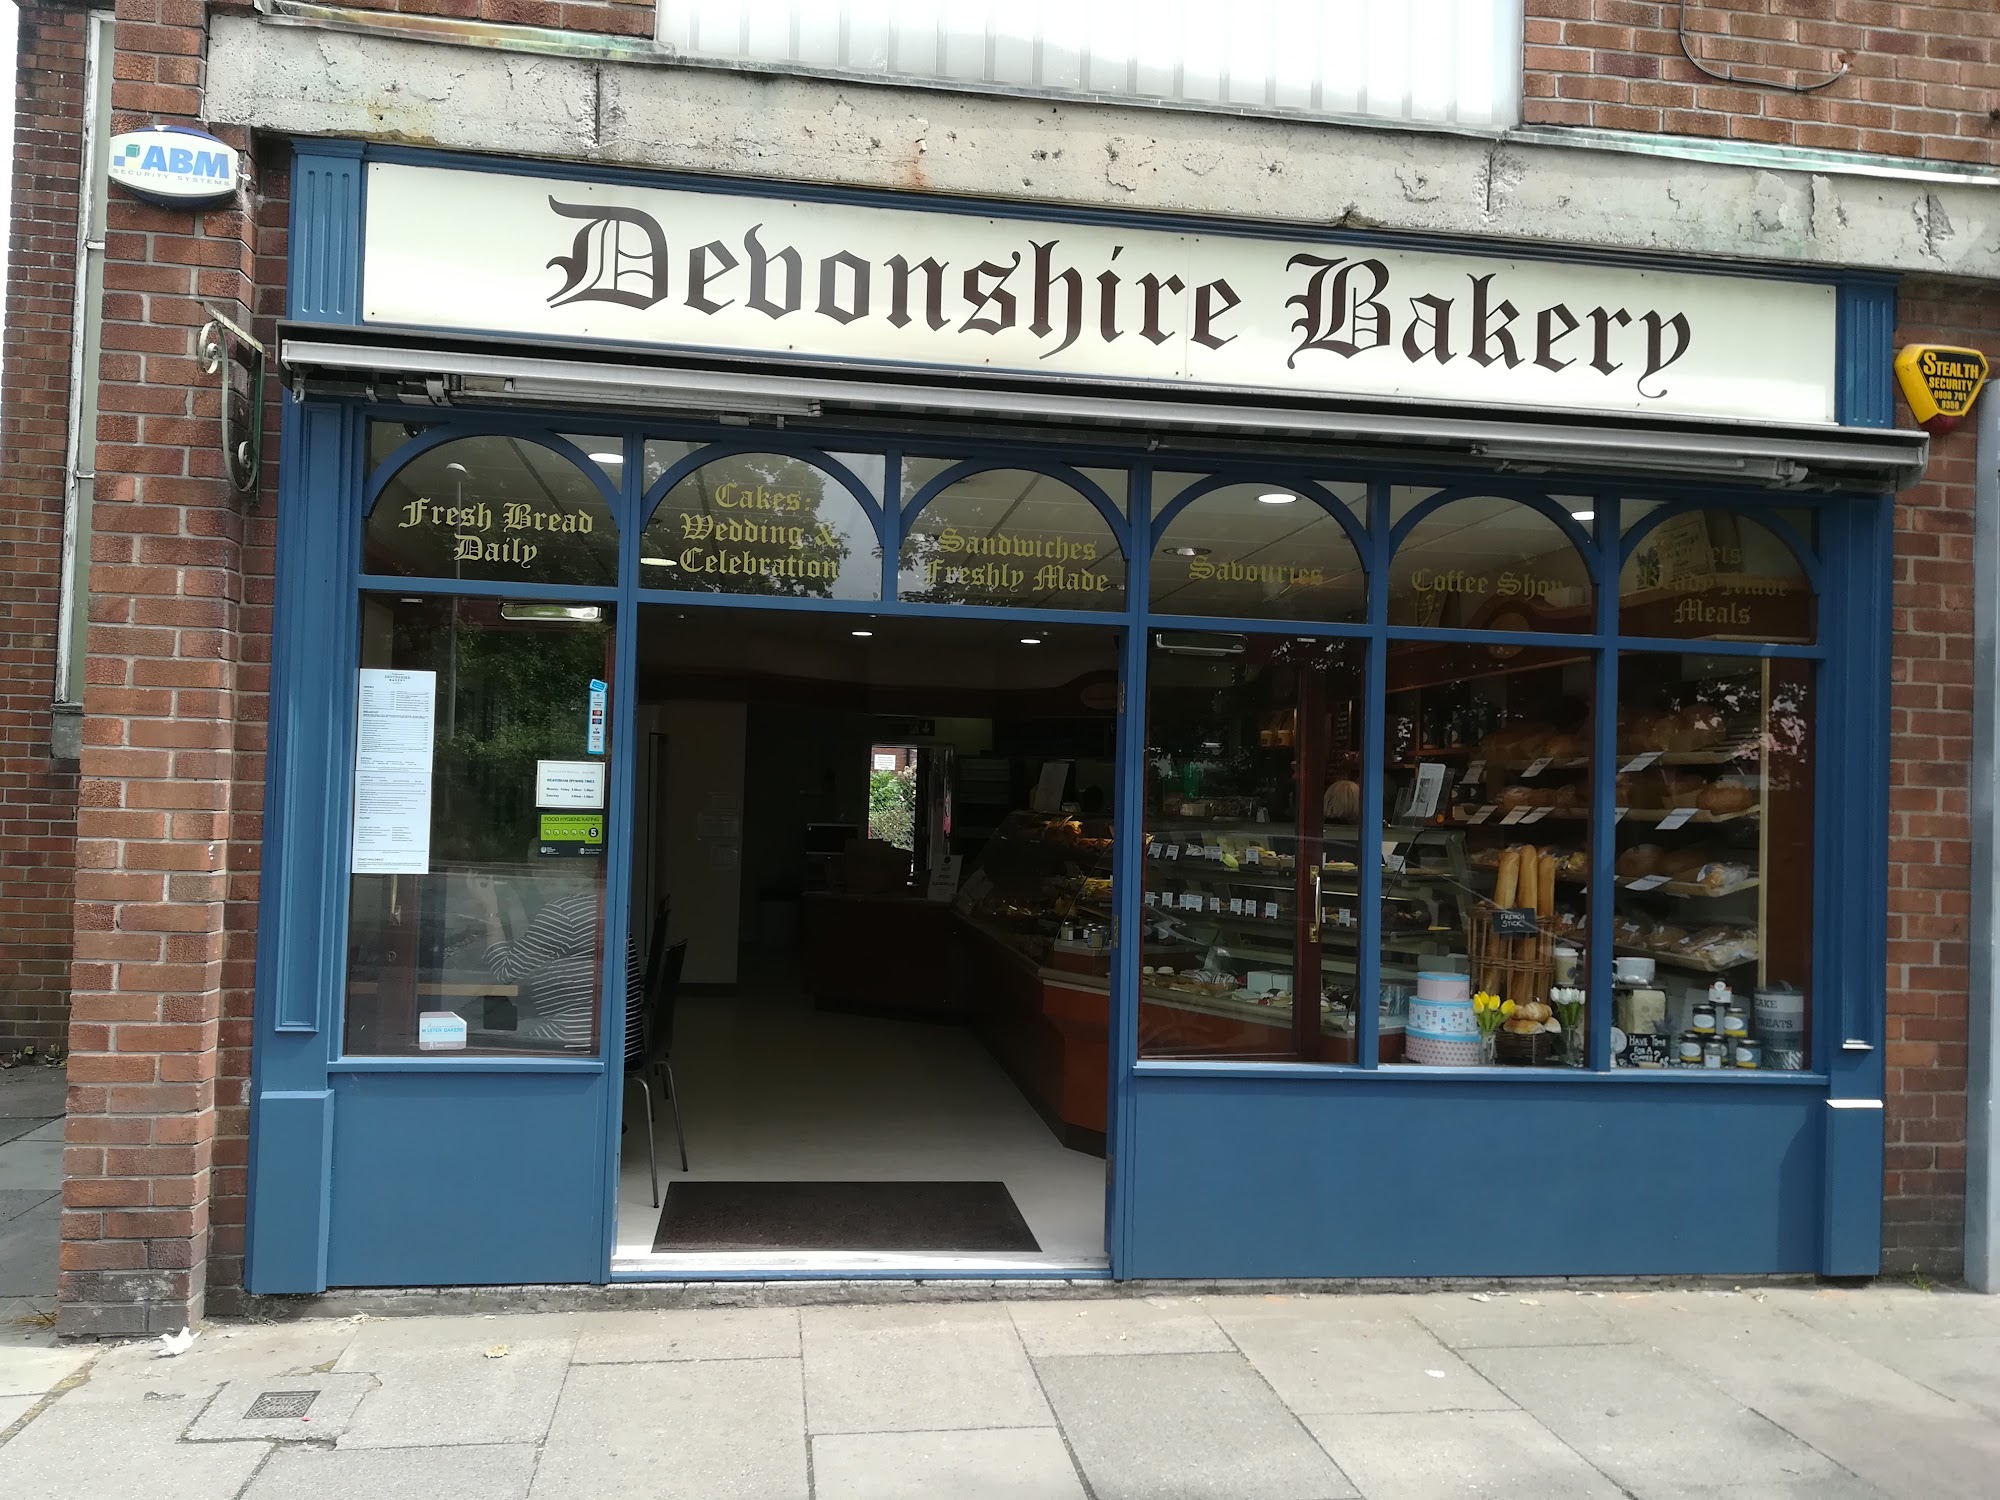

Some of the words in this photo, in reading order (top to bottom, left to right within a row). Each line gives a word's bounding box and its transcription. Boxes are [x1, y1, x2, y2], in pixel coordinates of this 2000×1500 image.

[113, 168, 170, 179] SECURITY
[177, 175, 231, 186] SYSTEMS
[140, 145, 230, 180] ABM
[546, 194, 1242, 361] Devonshire
[1284, 252, 1692, 399] Bakery
[1923, 351, 1979, 380] STEALTH
[1928, 376, 1973, 392] SECURITY
[398, 497, 492, 533] Fresh
[502, 501, 594, 535] Bread
[679, 512, 805, 551] Wedding
[814, 521, 840, 549] &
[453, 533, 538, 570] Daily
[937, 526, 1097, 564] Sandwiches
[679, 547, 840, 580] Celebration
[924, 559, 1024, 594] Freshly
[1032, 563, 1110, 593] Made
[1188, 553, 1325, 587] Savouries
[1410, 566, 1489, 598] Coffee
[1673, 597, 1752, 626] Meals
[590, 828, 597, 837] 5
[1500, 913, 1526, 921] FRENCH
[1501, 920, 1525, 928] STICK
[1757, 1017, 1793, 1029] REATS
[1646, 1046, 1653, 1055] A
